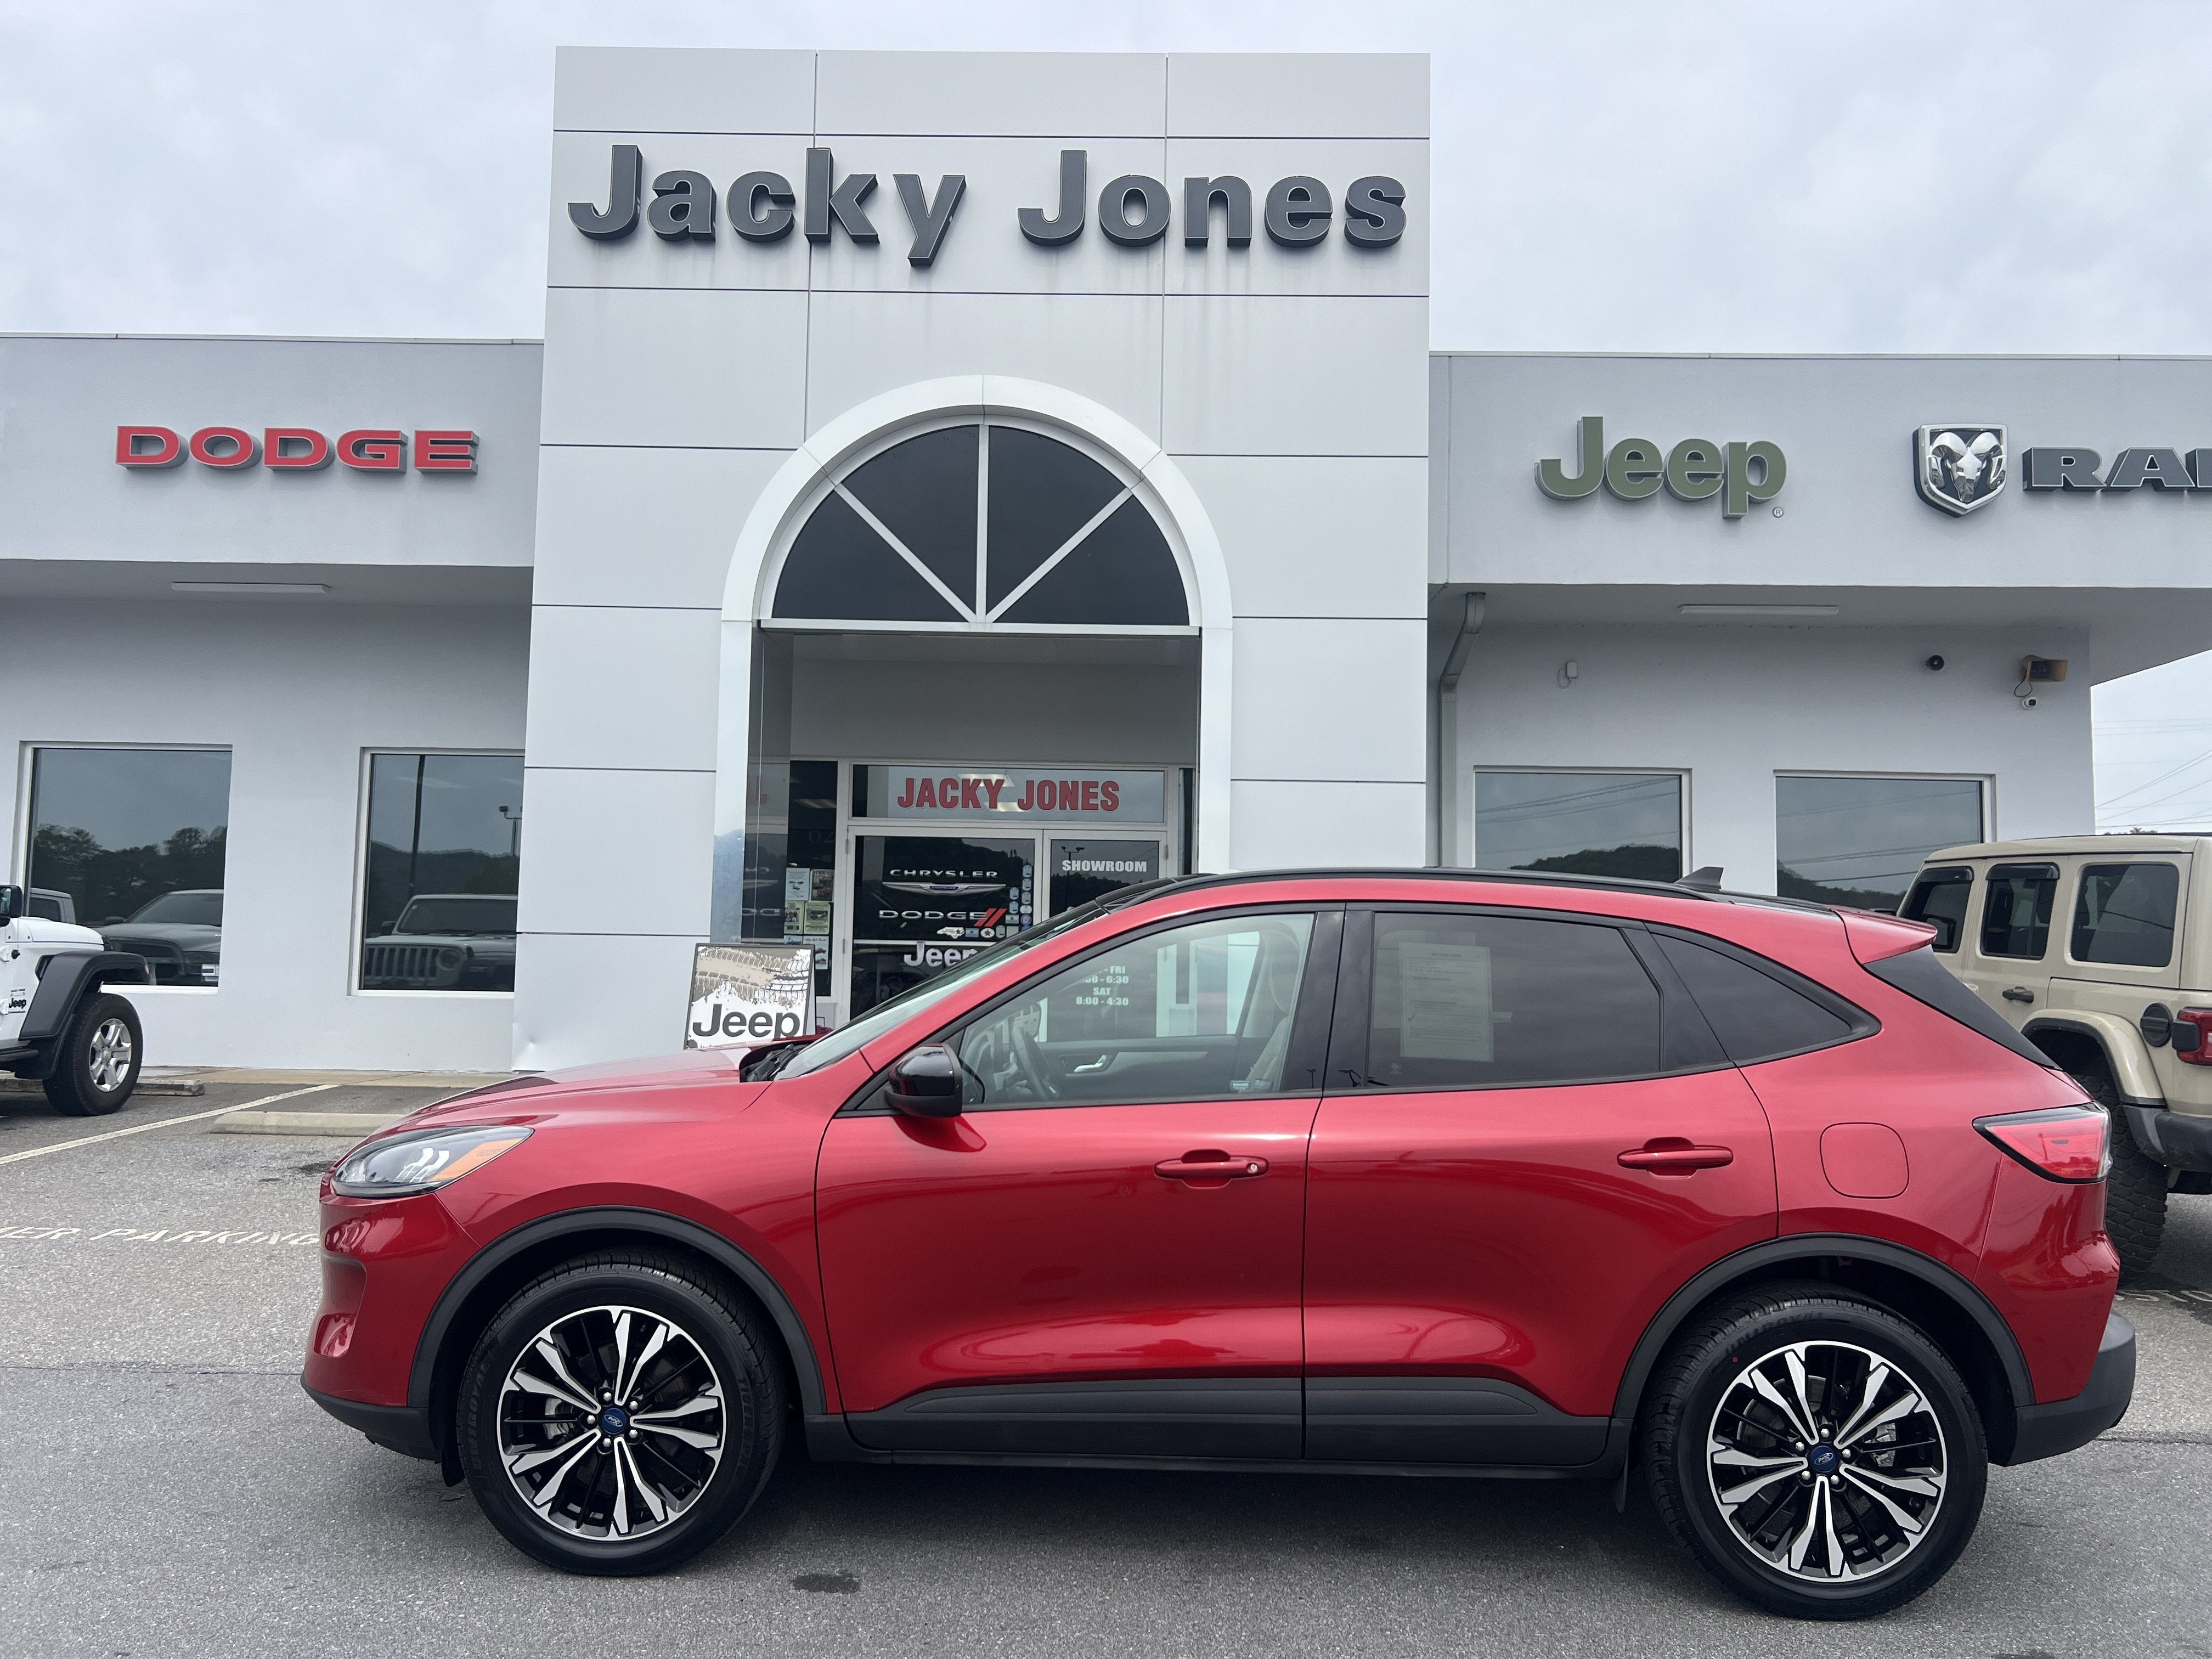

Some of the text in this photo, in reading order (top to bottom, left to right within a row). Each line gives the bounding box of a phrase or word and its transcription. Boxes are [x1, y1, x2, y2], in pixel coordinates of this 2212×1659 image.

[567, 145, 1407, 266] Jacky Jones
[115, 426, 478, 474] DODGE
[1534, 416, 1787, 519] Jeep
[2022, 447, 2212, 492] RA
[897, 777, 1120, 811] JACKY JONES
[1062, 860, 1147, 872] SHOWROOM
[889, 869, 998, 878] CHRYSLER
[879, 910, 988, 921] DODGE
[1110, 966, 1126, 974] FRI
[1106, 975, 1129, 984] 6:30
[1093, 987, 1111, 995] SAT
[9, 997, 26, 1009] Jeep
[1076, 996, 1099, 1005] 8:00
[1106, 997, 1129, 1006] 4:30
[692, 1003, 800, 1039] Jeep
[89, 1228, 320, 1245] PARKING
